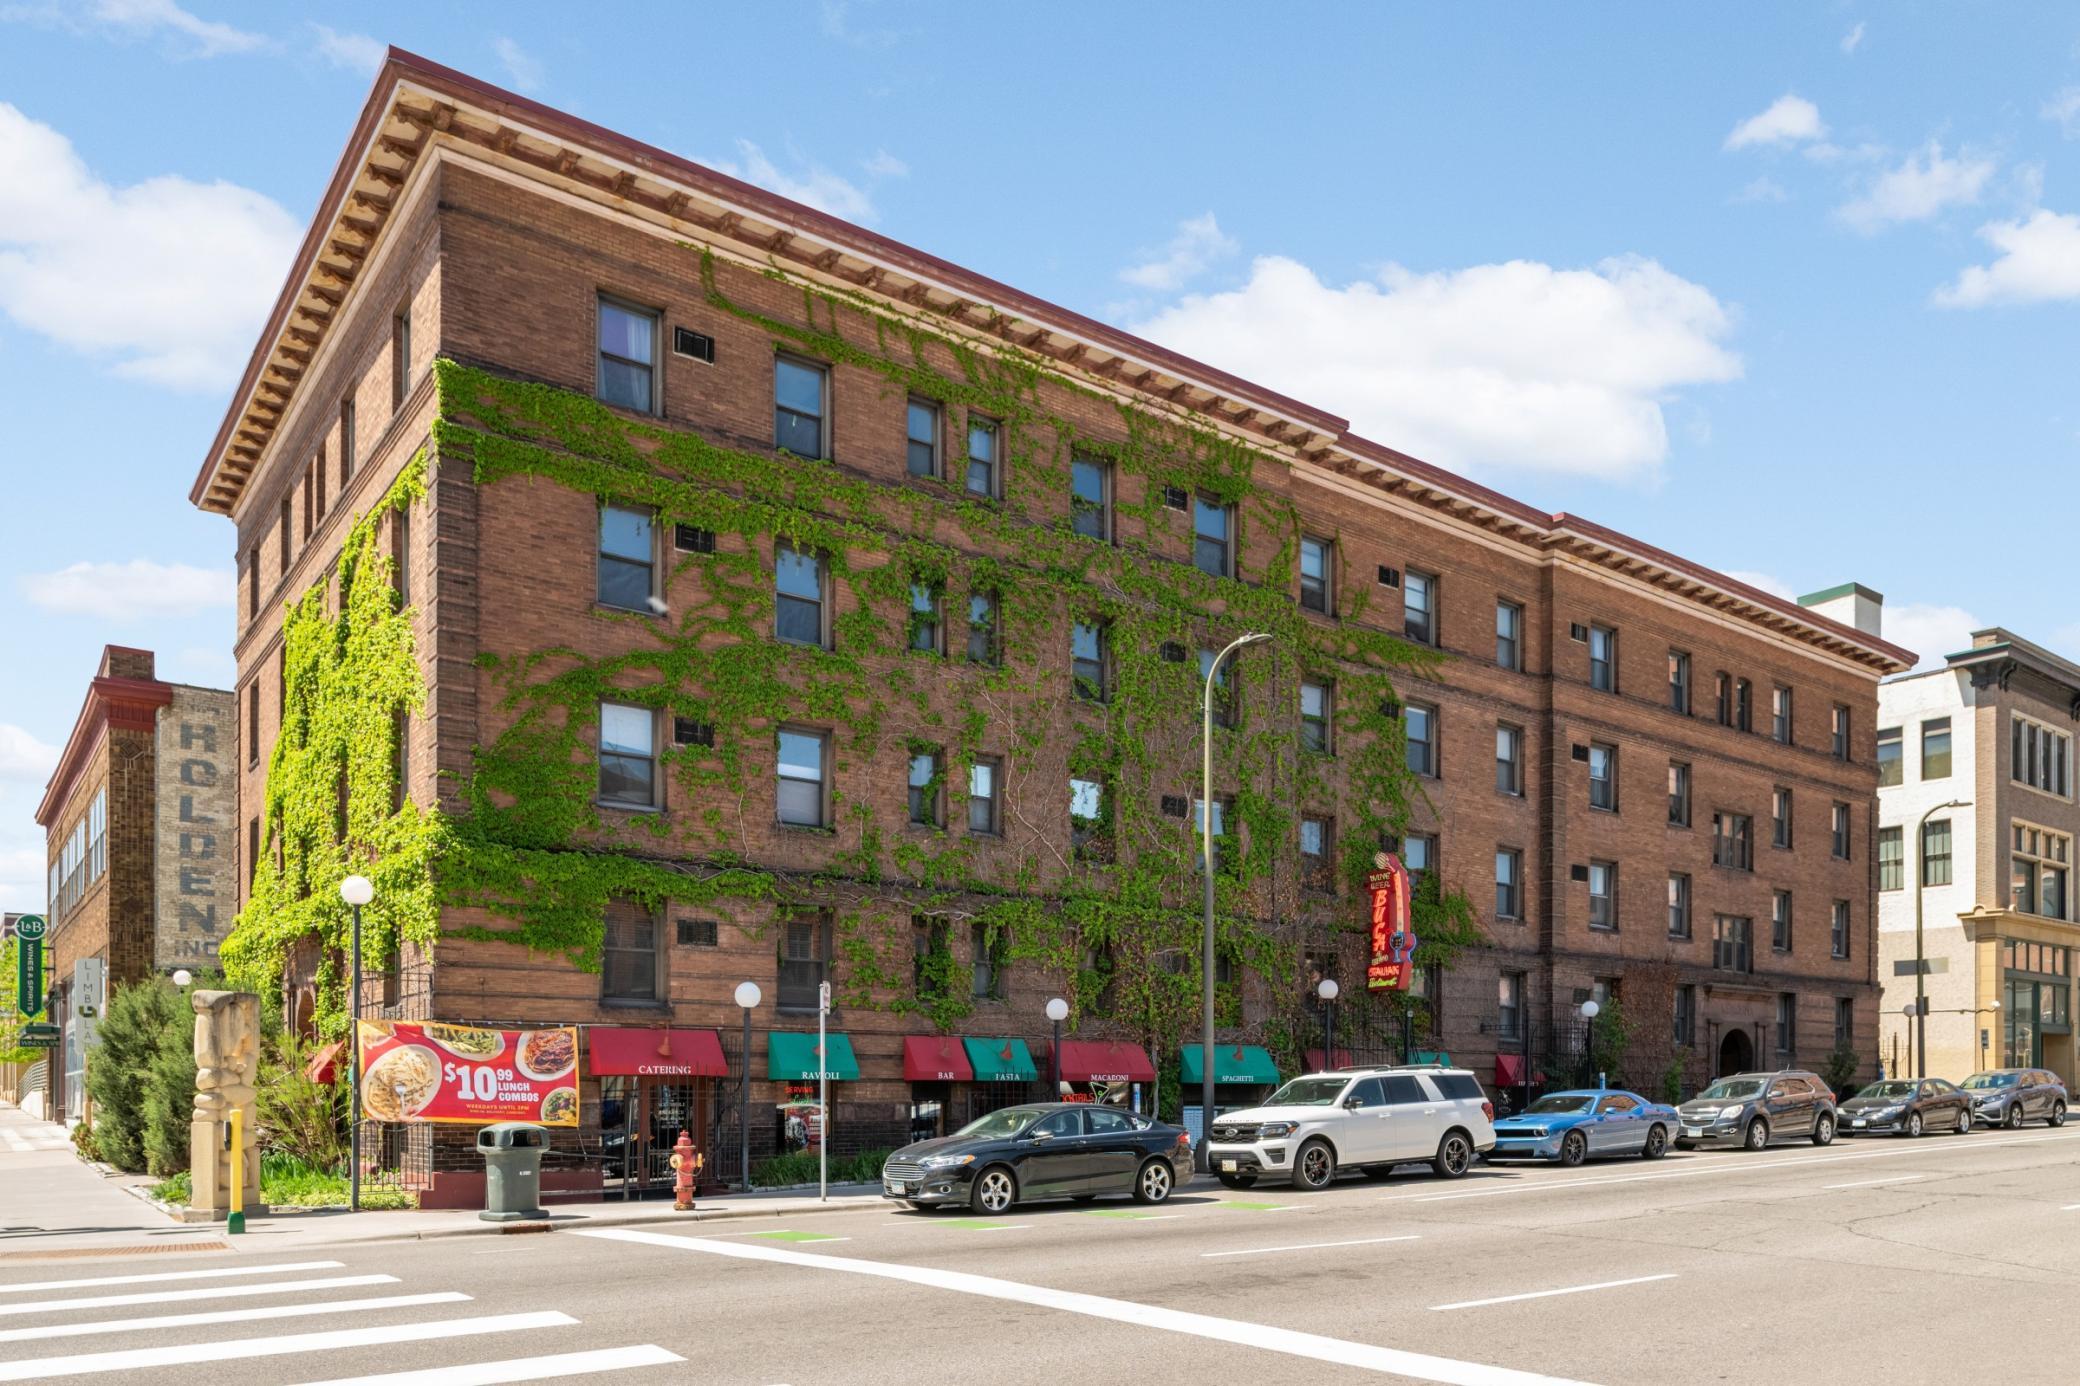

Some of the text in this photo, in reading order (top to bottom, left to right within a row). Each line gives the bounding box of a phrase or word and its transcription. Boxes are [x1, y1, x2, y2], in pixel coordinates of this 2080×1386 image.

[179, 722, 217, 933] HOLDEN
[21, 921, 42, 933] L&B
[175, 939, 219, 957] INC
[27, 944, 35, 971] WINES
[84, 961, 93, 1004] LIMB
[638, 1065, 691, 1075] CATERING
[802, 1071, 840, 1080] RAVOLI
[938, 1071, 954, 1080] BAR
[995, 1073, 1020, 1081] PASTA
[498, 1082, 530, 1092] LUNCH
[499, 1092, 539, 1102] COMBOS
